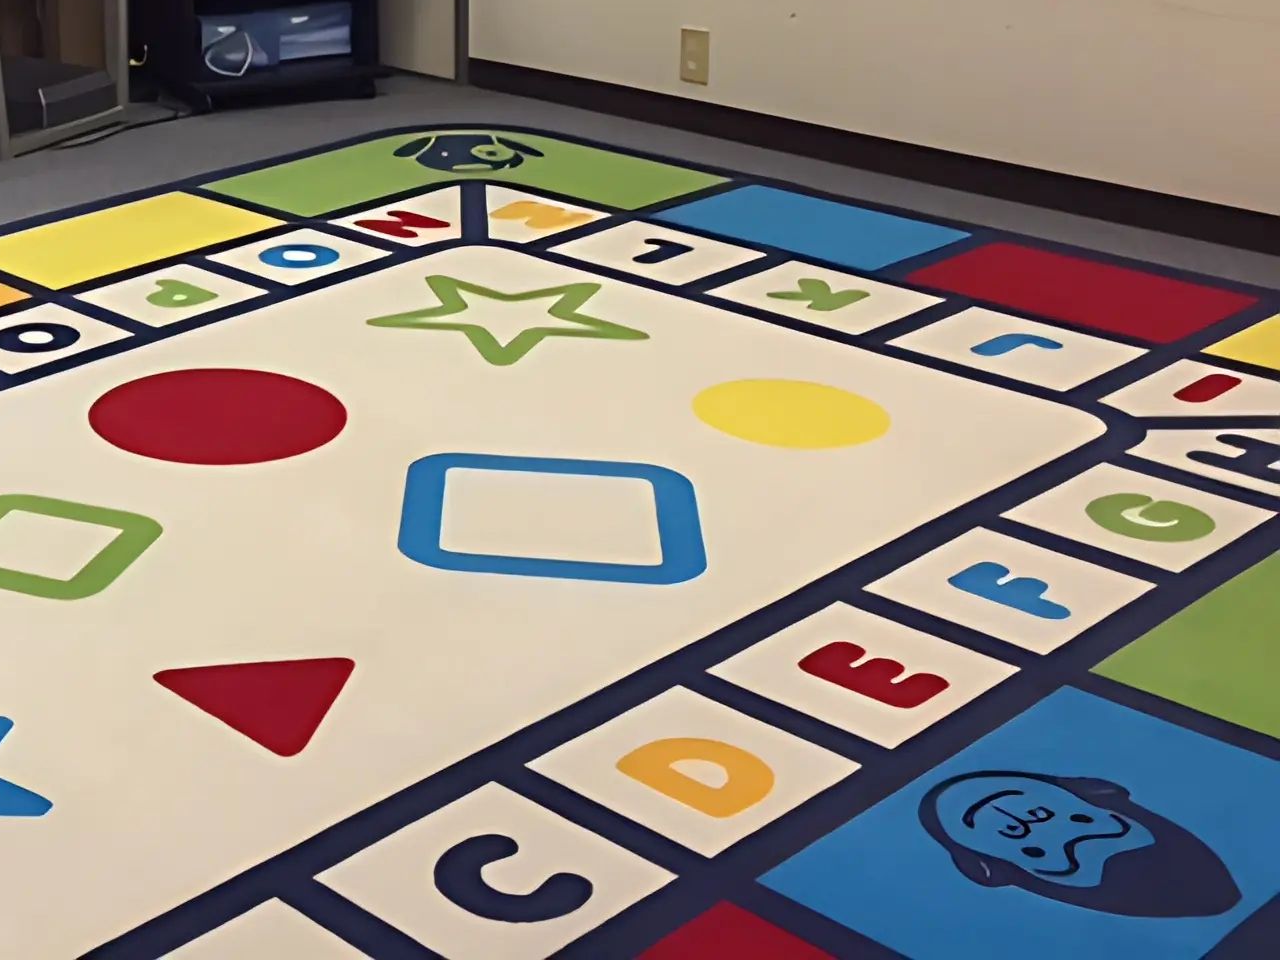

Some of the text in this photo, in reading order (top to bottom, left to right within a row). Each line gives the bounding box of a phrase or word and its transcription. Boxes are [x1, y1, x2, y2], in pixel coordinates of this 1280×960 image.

[257, 243, 340, 270] O
[632, 238, 695, 265] L
[147, 278, 218, 309] P
[765, 277, 871, 312] K
[433, 833, 594, 924] C
[615, 736, 777, 820] D
[797, 640, 951, 710] E
[947, 561, 1072, 620] F
[1085, 492, 1217, 543] G
